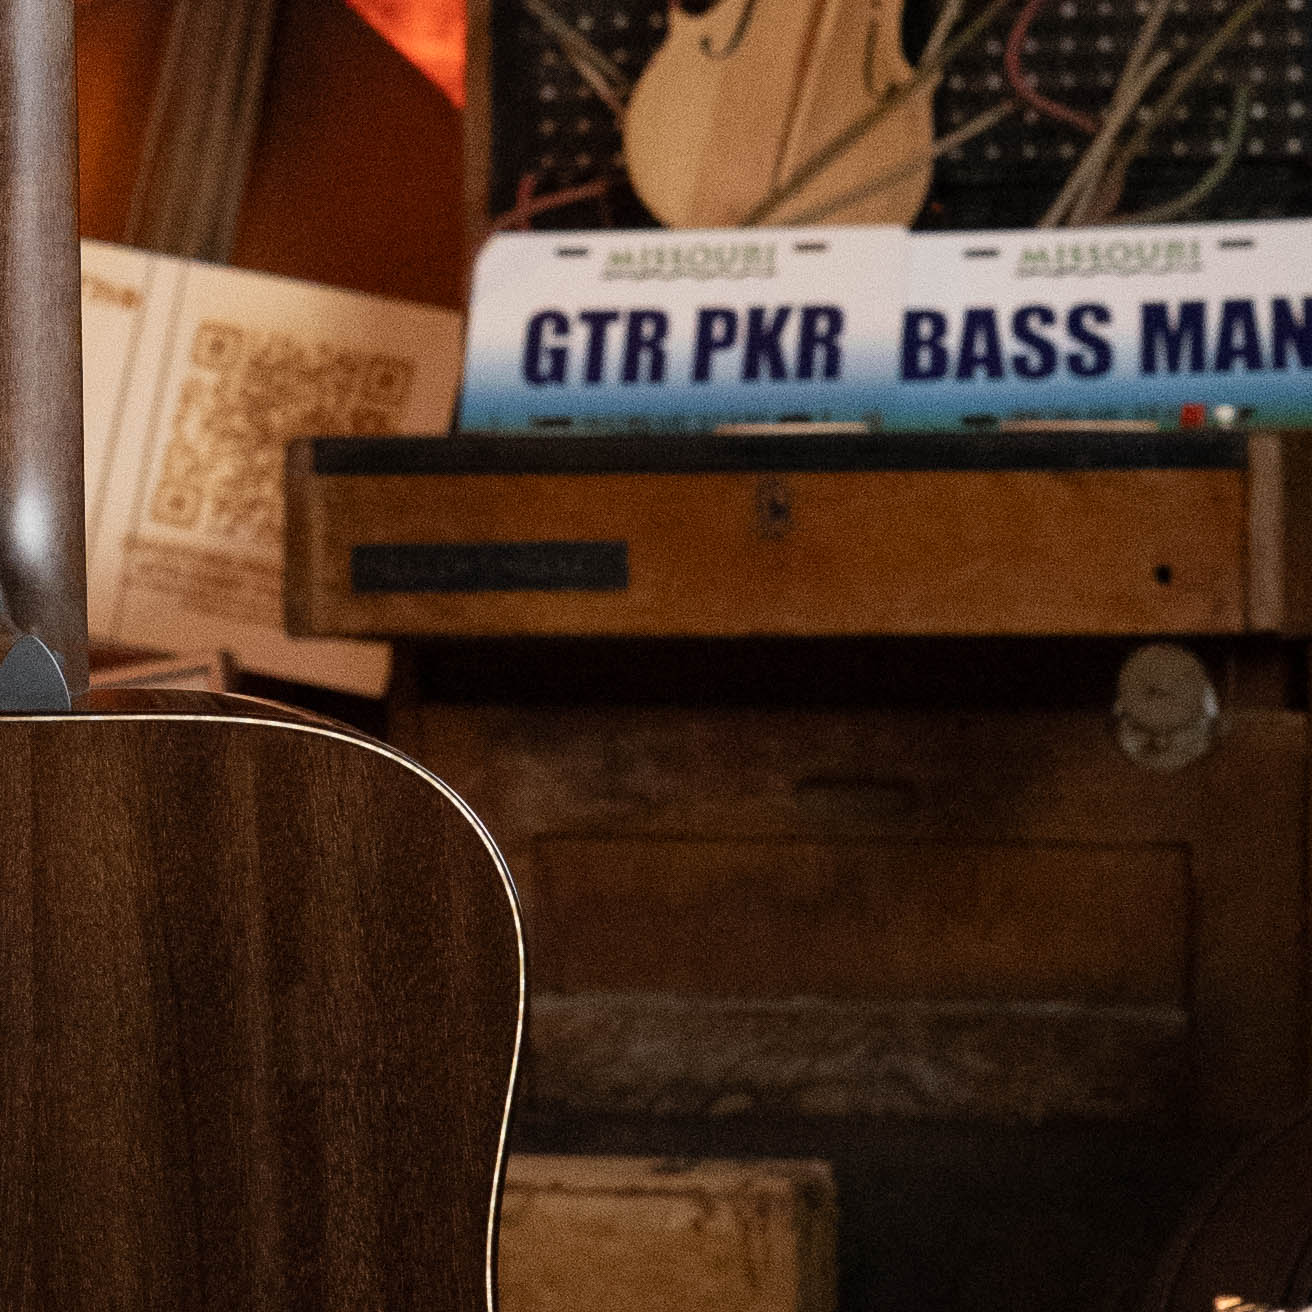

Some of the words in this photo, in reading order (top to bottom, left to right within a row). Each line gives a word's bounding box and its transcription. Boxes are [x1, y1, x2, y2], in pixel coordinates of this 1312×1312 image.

[605, 244, 778, 272] MISSOURI
[1019, 240, 1202, 269] MISSOURI
[523, 308, 669, 386] GTR
[691, 304, 846, 383] PKR
[899, 303, 1113, 382] BASS
[1140, 297, 1312, 375] MAN
